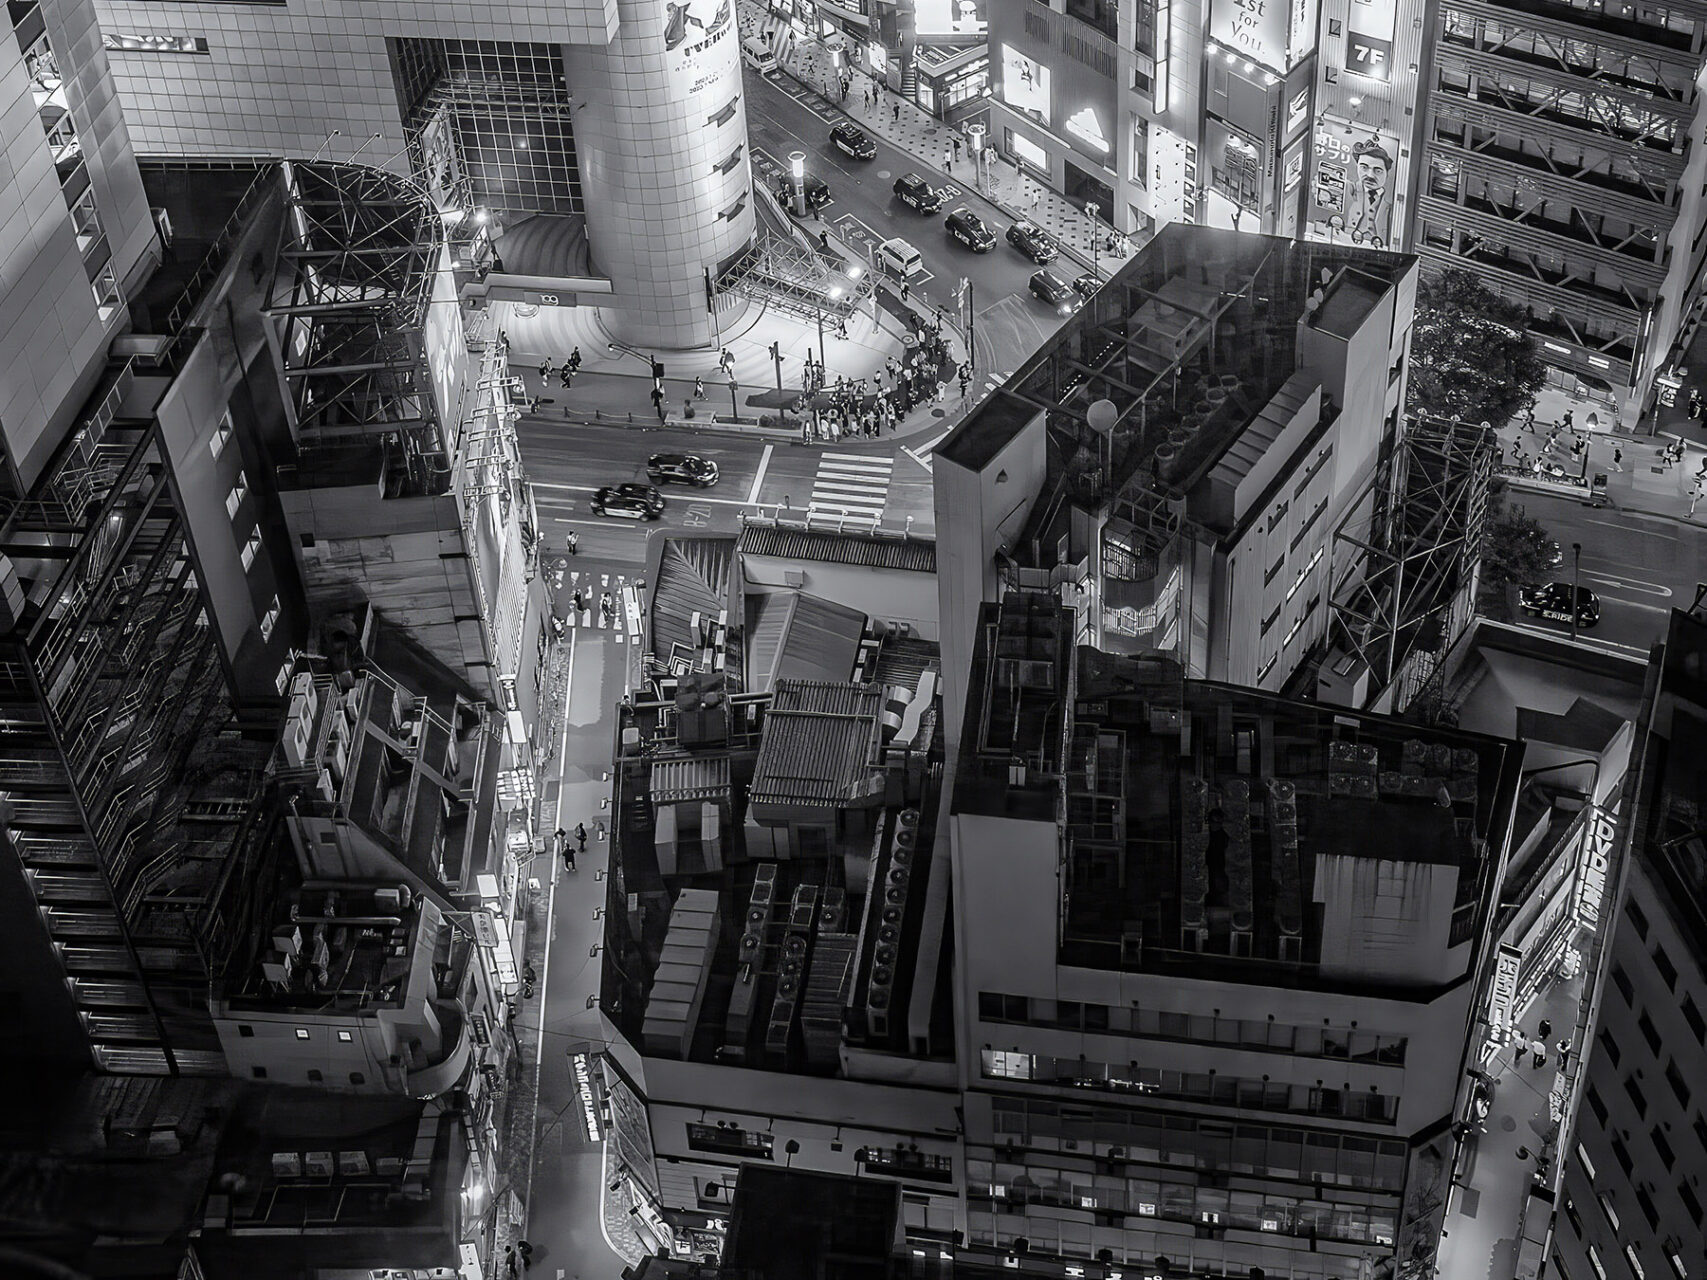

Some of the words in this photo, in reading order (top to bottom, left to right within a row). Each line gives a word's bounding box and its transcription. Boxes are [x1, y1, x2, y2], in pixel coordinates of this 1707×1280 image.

[1238, 11, 1259, 28] for
[1353, 44, 1385, 65] 7F
[1314, 144, 1351, 164] サプリ
